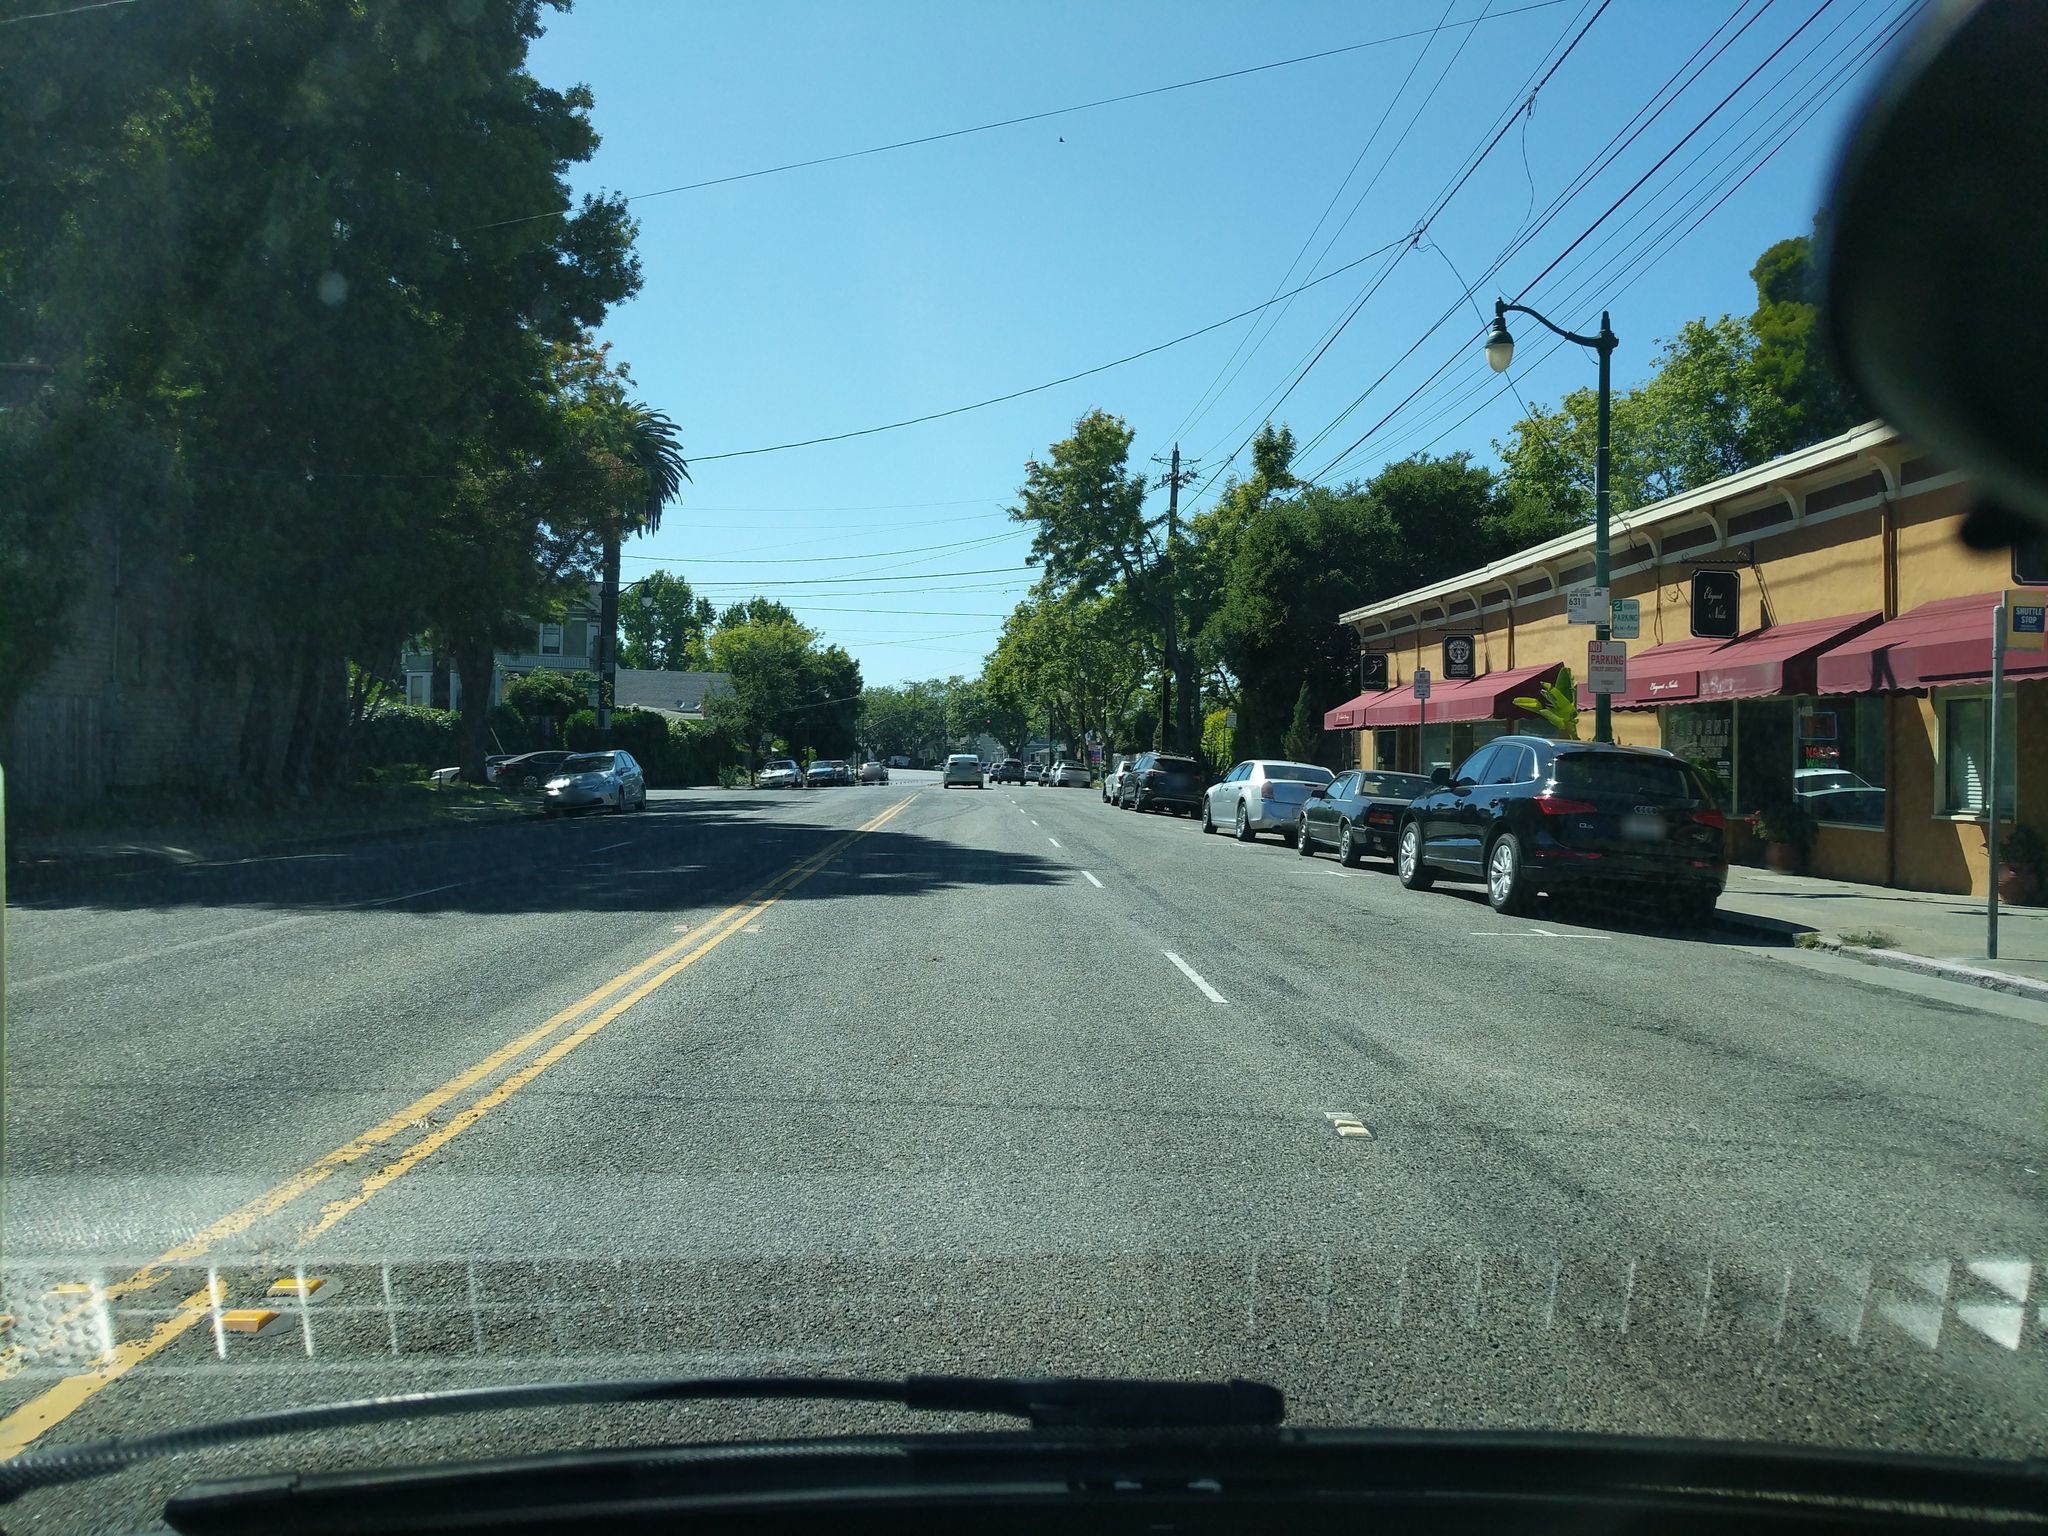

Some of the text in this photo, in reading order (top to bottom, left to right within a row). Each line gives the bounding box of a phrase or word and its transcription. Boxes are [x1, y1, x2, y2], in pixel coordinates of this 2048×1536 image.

[1568, 597, 1581, 606] 631
[1614, 600, 1621, 610] 2
[2015, 607, 2043, 616] SHUTTLE
[1613, 614, 1638, 622] PARKING
[2020, 615, 2038, 624] STOP
[1590, 641, 1601, 652] NO
[1590, 654, 1624, 665] PARKING
